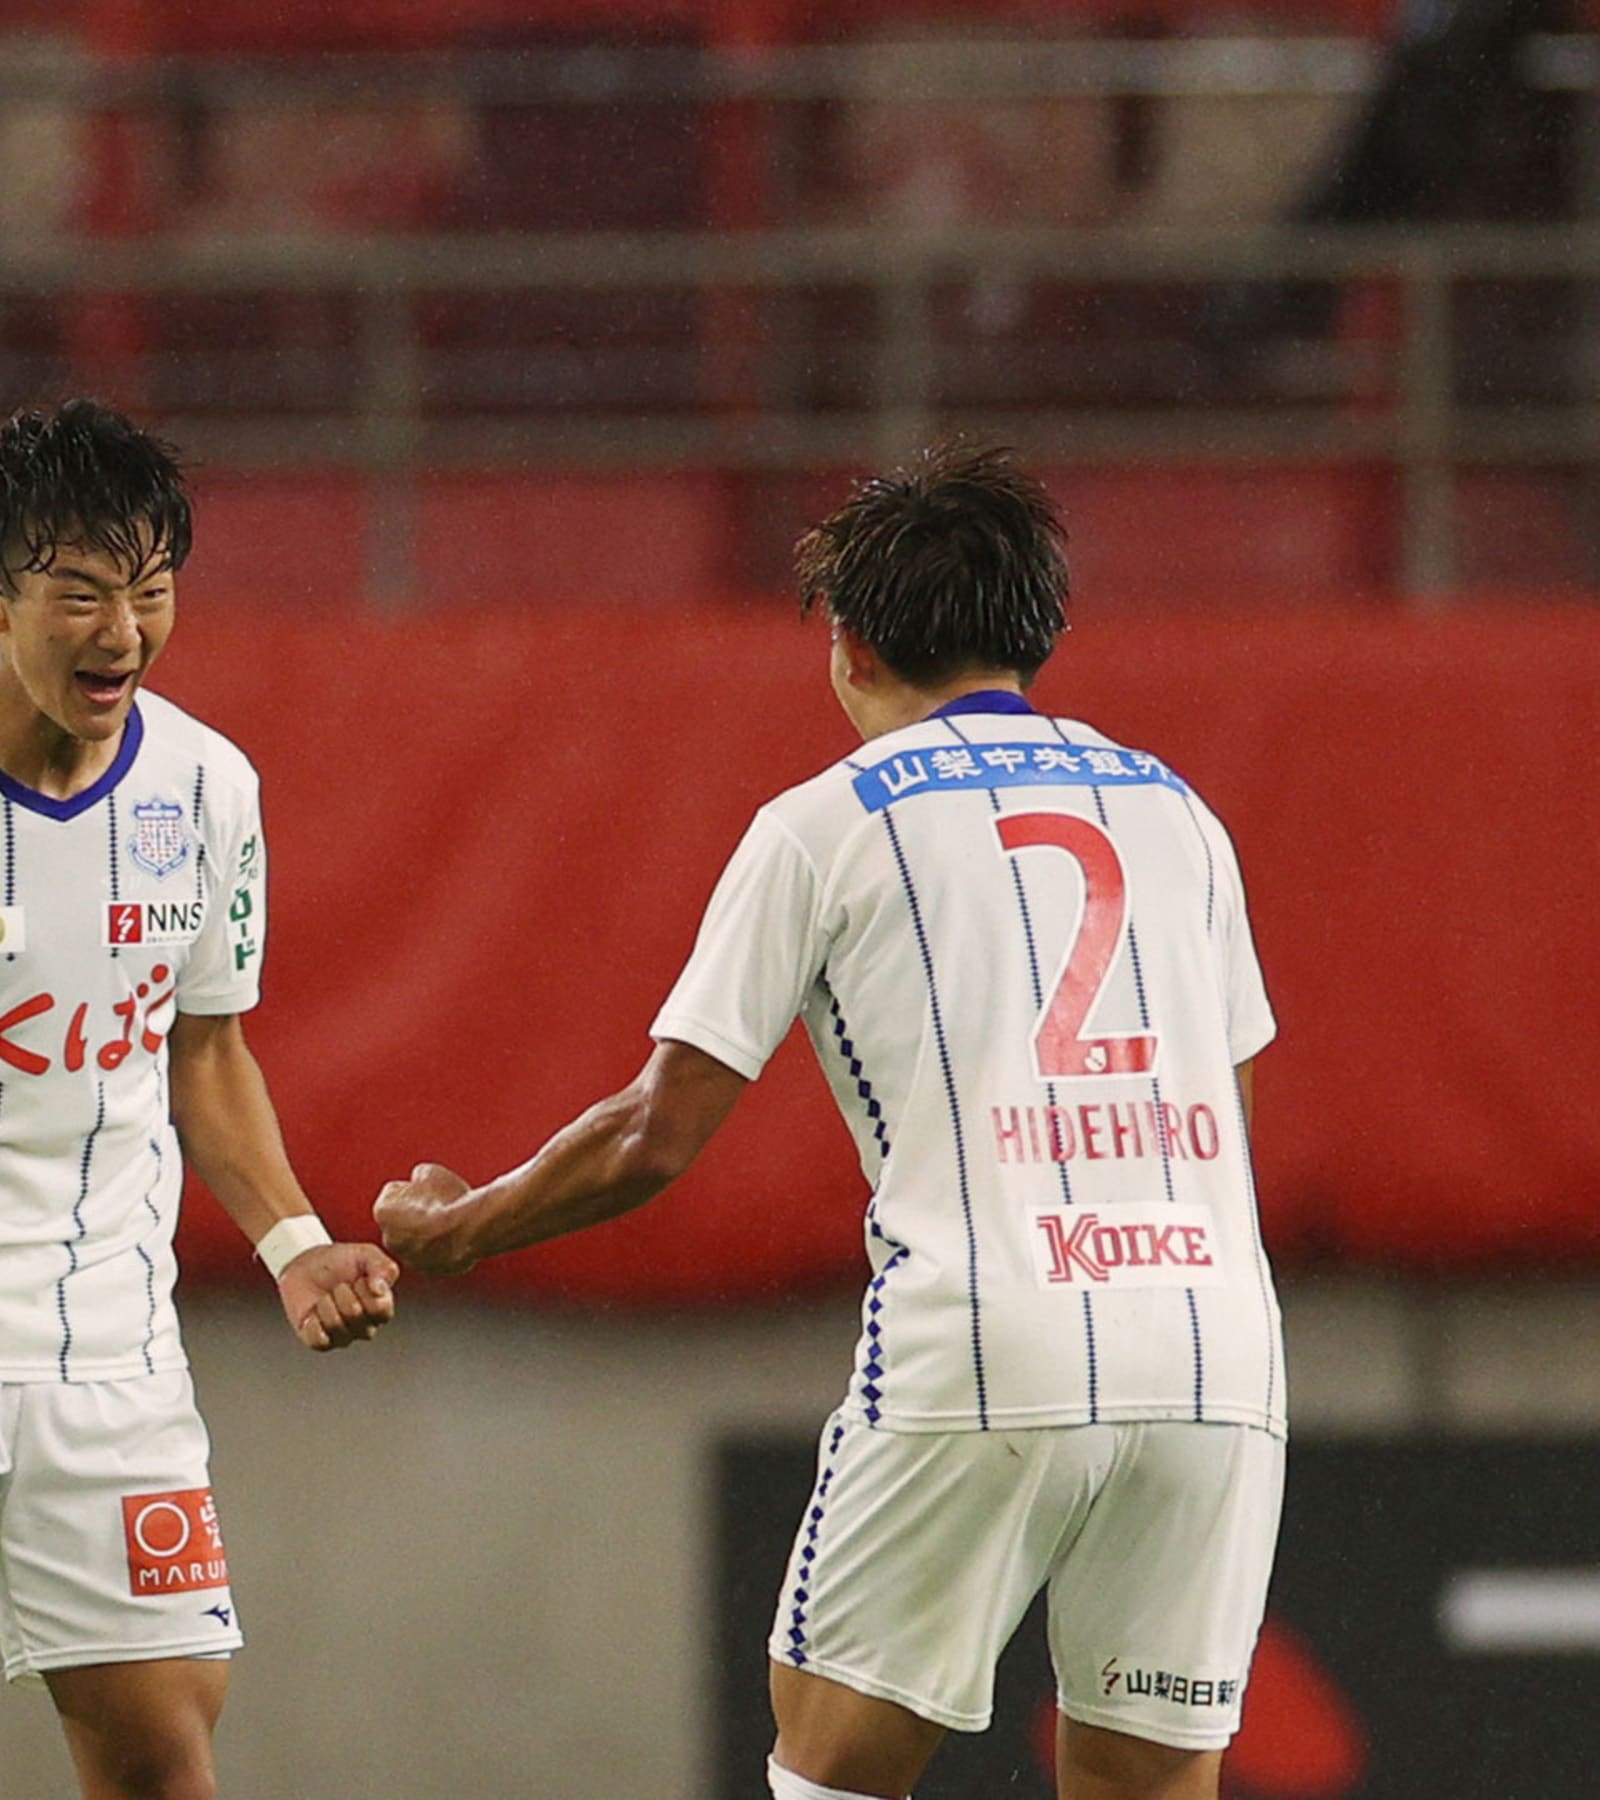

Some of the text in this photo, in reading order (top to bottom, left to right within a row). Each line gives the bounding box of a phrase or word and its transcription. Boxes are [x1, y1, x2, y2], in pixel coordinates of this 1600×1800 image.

[148, 902, 203, 932] NNS
[995, 812, 1157, 1076] 2
[992, 1102, 1220, 1163] HIDEHIRO
[1037, 1213, 1214, 1283] KOIKE
